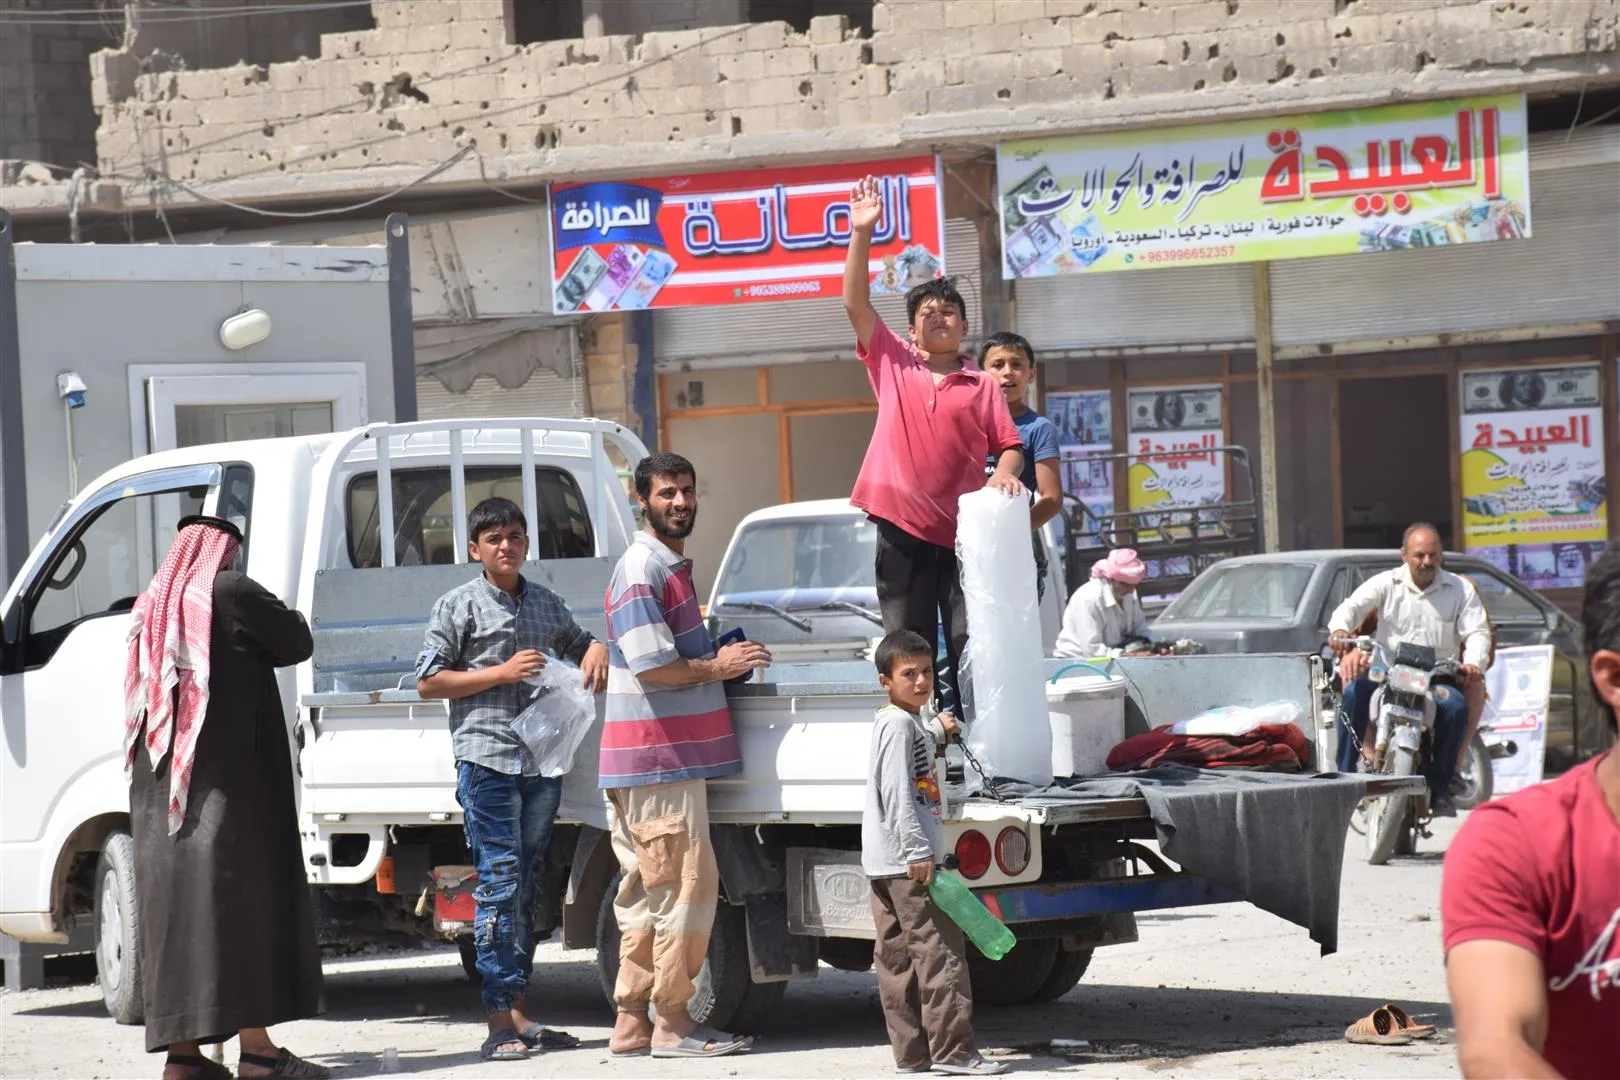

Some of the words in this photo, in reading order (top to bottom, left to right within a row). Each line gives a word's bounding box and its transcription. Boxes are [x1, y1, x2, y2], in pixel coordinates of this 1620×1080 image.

[1154, 144, 1246, 223] للصرافة
[1260, 107, 1499, 216] العبيدة
[562, 198, 650, 236] للصرافة
[684, 175, 910, 257] المانة
[1473, 415, 1591, 453] العبيدة
[831, 876, 861, 899] KIA
